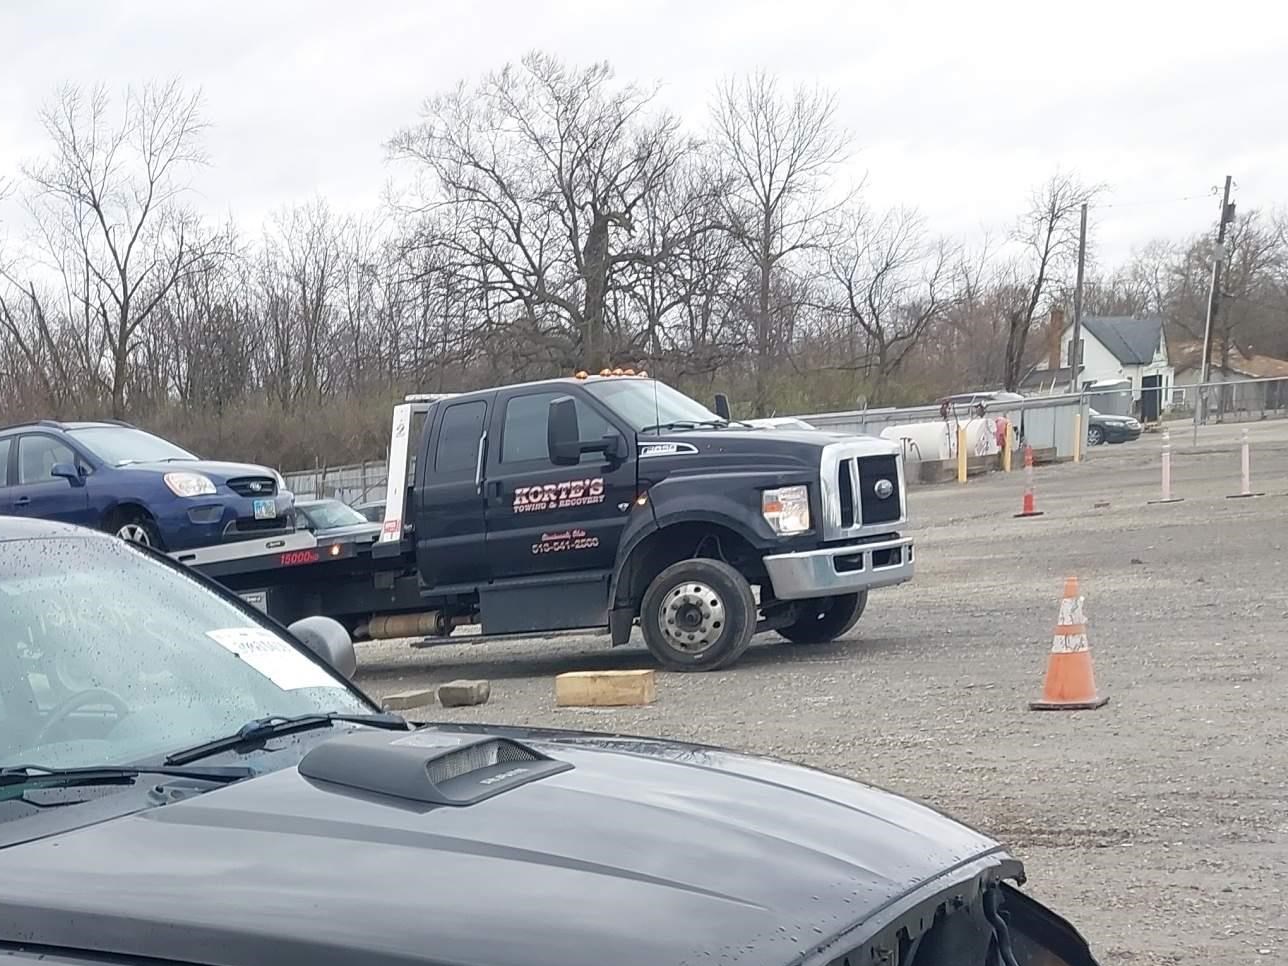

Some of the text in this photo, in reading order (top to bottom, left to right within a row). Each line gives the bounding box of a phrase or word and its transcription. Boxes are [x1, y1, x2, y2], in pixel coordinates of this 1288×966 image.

[513, 478, 604, 505] KORTE'S
[513, 502, 547, 513] TOWING
[559, 495, 605, 507] RECOVERY
